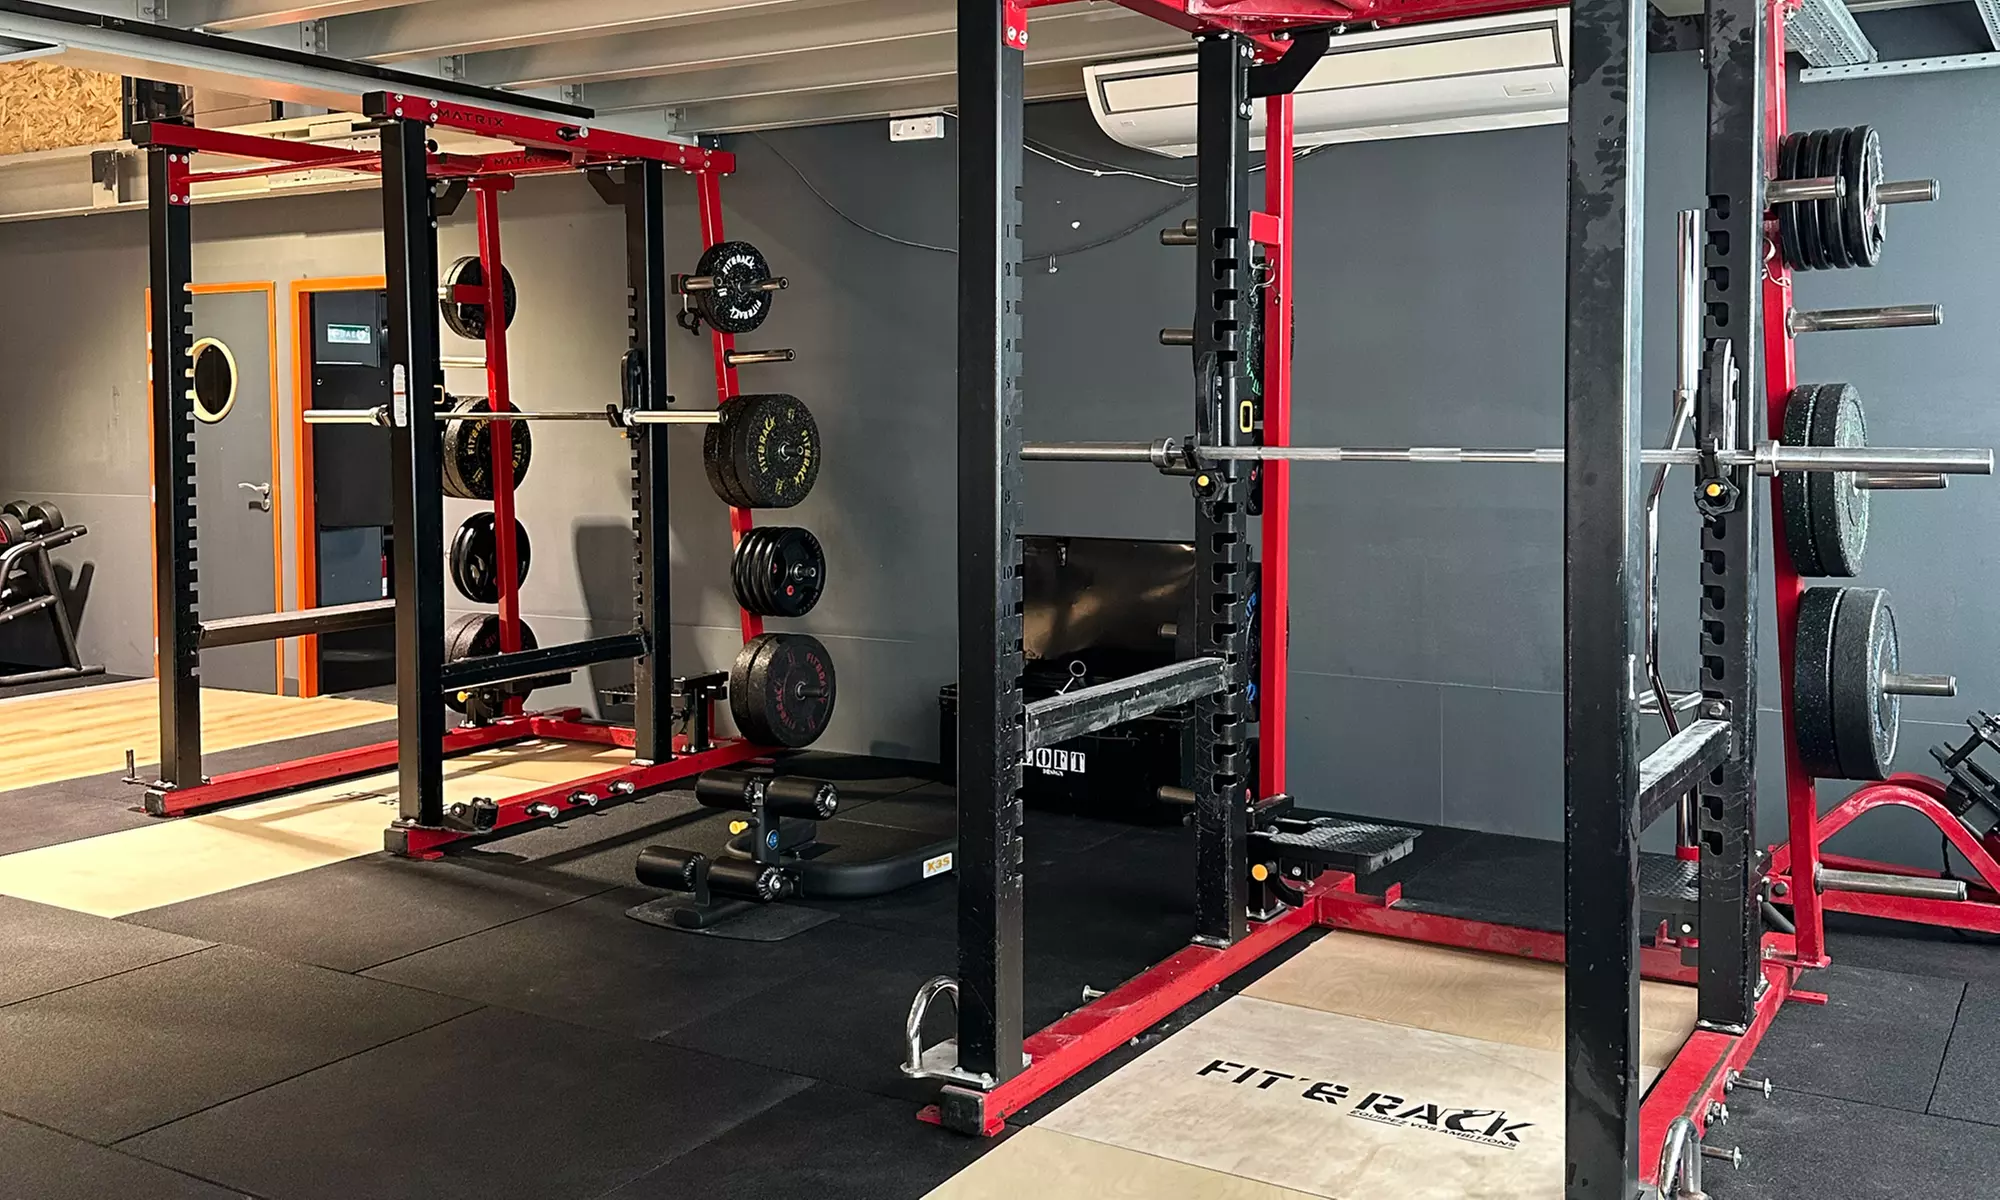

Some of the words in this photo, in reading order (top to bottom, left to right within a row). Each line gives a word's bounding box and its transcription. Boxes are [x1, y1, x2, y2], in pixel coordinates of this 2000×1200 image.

[437, 108, 504, 127] MATRIX
[927, 856, 950, 872] K3S
[1410, 1122, 1437, 1132] VOS
[1439, 1128, 1518, 1148] AMBITIONS
